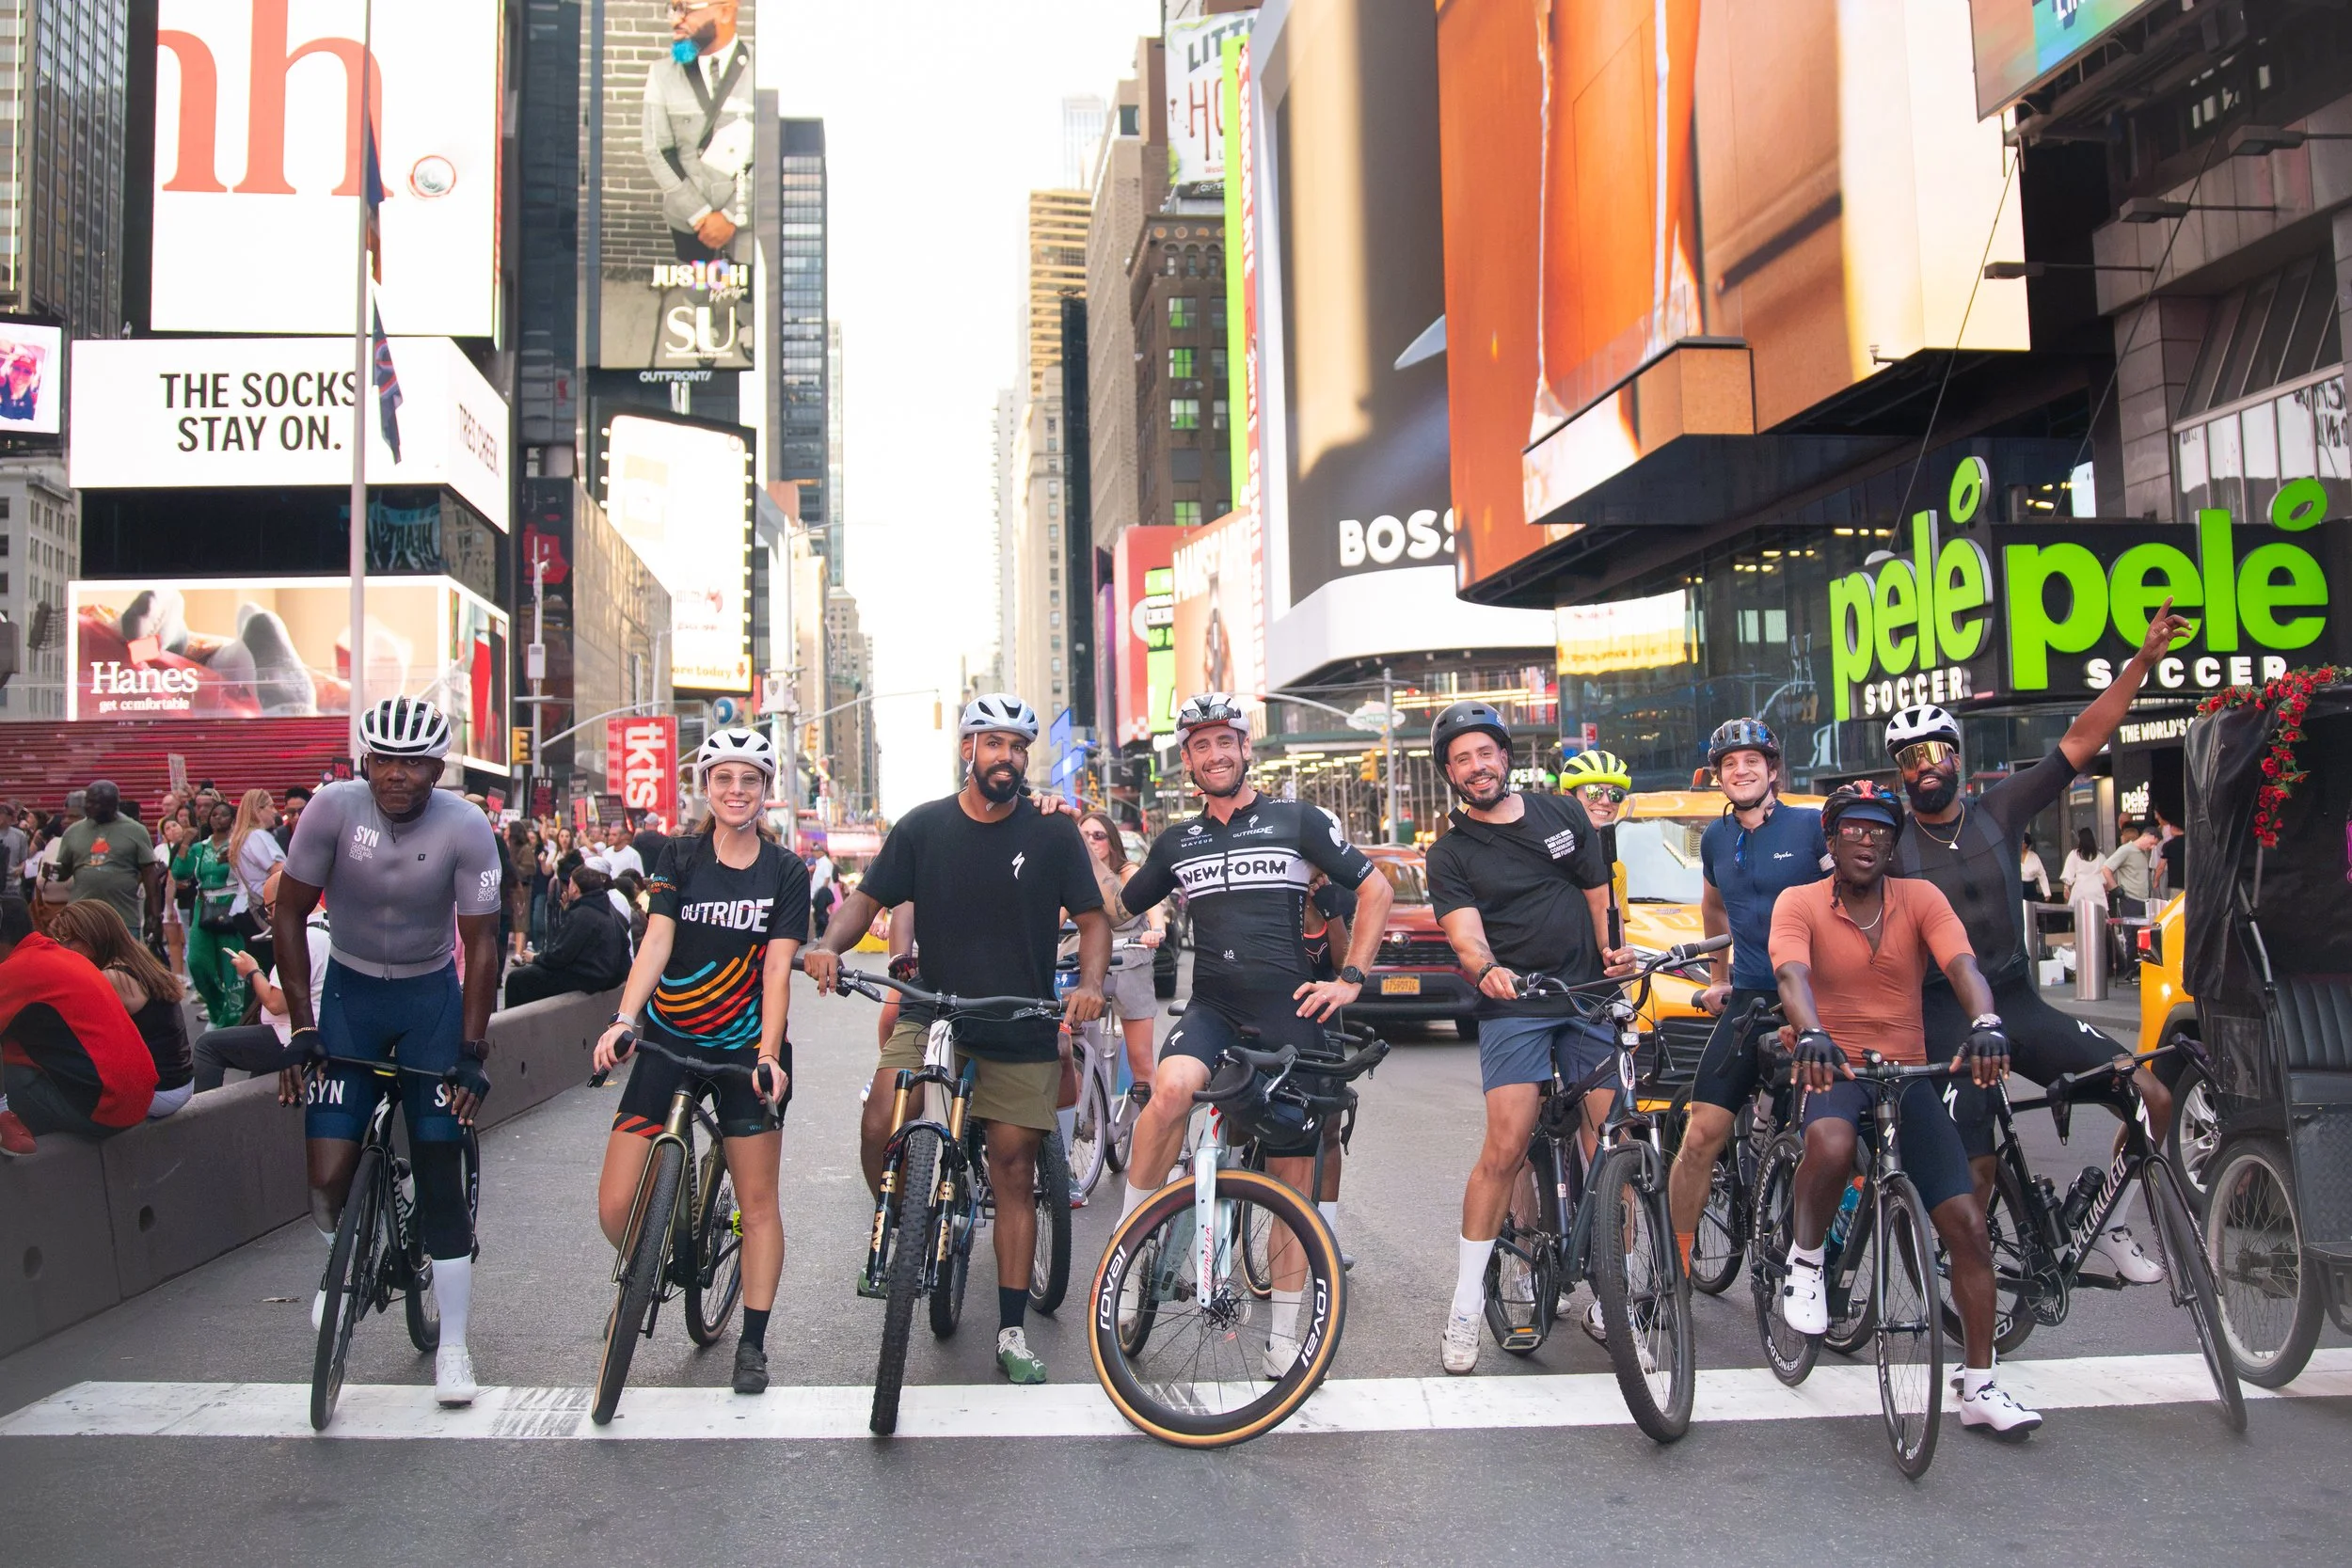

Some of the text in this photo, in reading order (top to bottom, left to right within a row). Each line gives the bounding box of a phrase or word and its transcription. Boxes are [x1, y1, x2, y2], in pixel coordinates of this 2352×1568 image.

[160, 372, 356, 408] THE SOCKS
[178, 415, 342, 451] STAY ON.
[1829, 456, 1990, 721] pelé
[2005, 478, 2329, 691] pelé
[90, 661, 199, 693] Hanes
[1865, 666, 1964, 715] SOCCER
[99, 697, 190, 713] get comfortable
[2120, 724, 2140, 744] THE
[2141, 718, 2186, 740] WORLD'S
[625, 722, 667, 808] tkts
[2122, 781, 2150, 813] pelé
[351, 841, 373, 853] GLOBAL
[354, 825, 380, 847] SYN
[1232, 825, 1274, 838] OUTRIDE
[348, 852, 364, 862] CLUB
[349, 848, 373, 859] CYCLING
[1182, 860, 1287, 885] NEWFORM
[681, 897, 774, 933] OUTRIDE
[308, 1080, 345, 1105] SYN
[2068, 1150, 2127, 1263] SPECIALIZED
[1100, 1244, 1127, 1331] roval
[1300, 1277, 1327, 1368] roval
[1766, 1336, 1800, 1371] REYNOLDS
